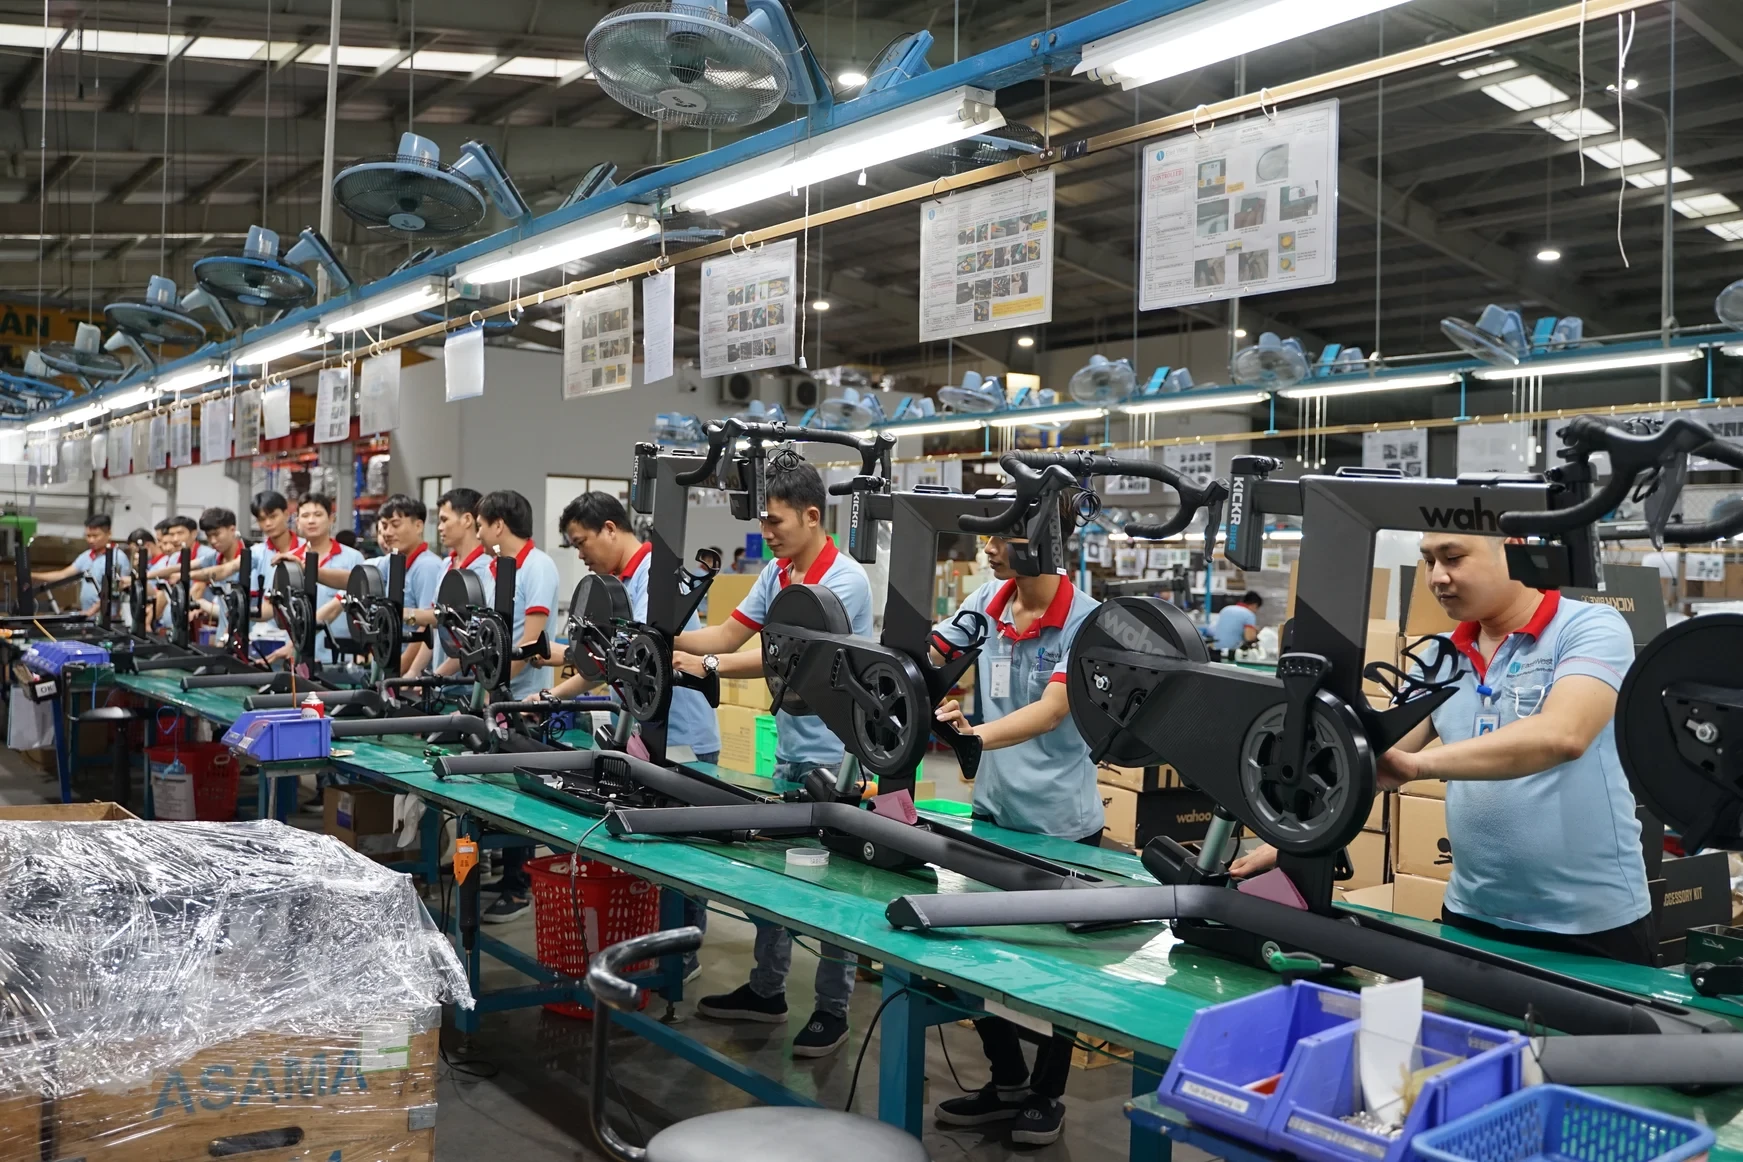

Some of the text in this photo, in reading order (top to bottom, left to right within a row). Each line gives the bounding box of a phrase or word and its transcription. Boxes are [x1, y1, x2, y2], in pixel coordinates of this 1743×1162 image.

[851, 491, 860, 528] KICKR
[1228, 476, 1245, 551] KICKR BIKE
[1419, 497, 1506, 532] wah
[1104, 610, 1166, 656] wah
[40, 684, 53, 694] OK
[1176, 809, 1212, 824] wahoo
[1663, 886, 1703, 907] CCESSORY KIT
[151, 1048, 368, 1120] ASAMA
